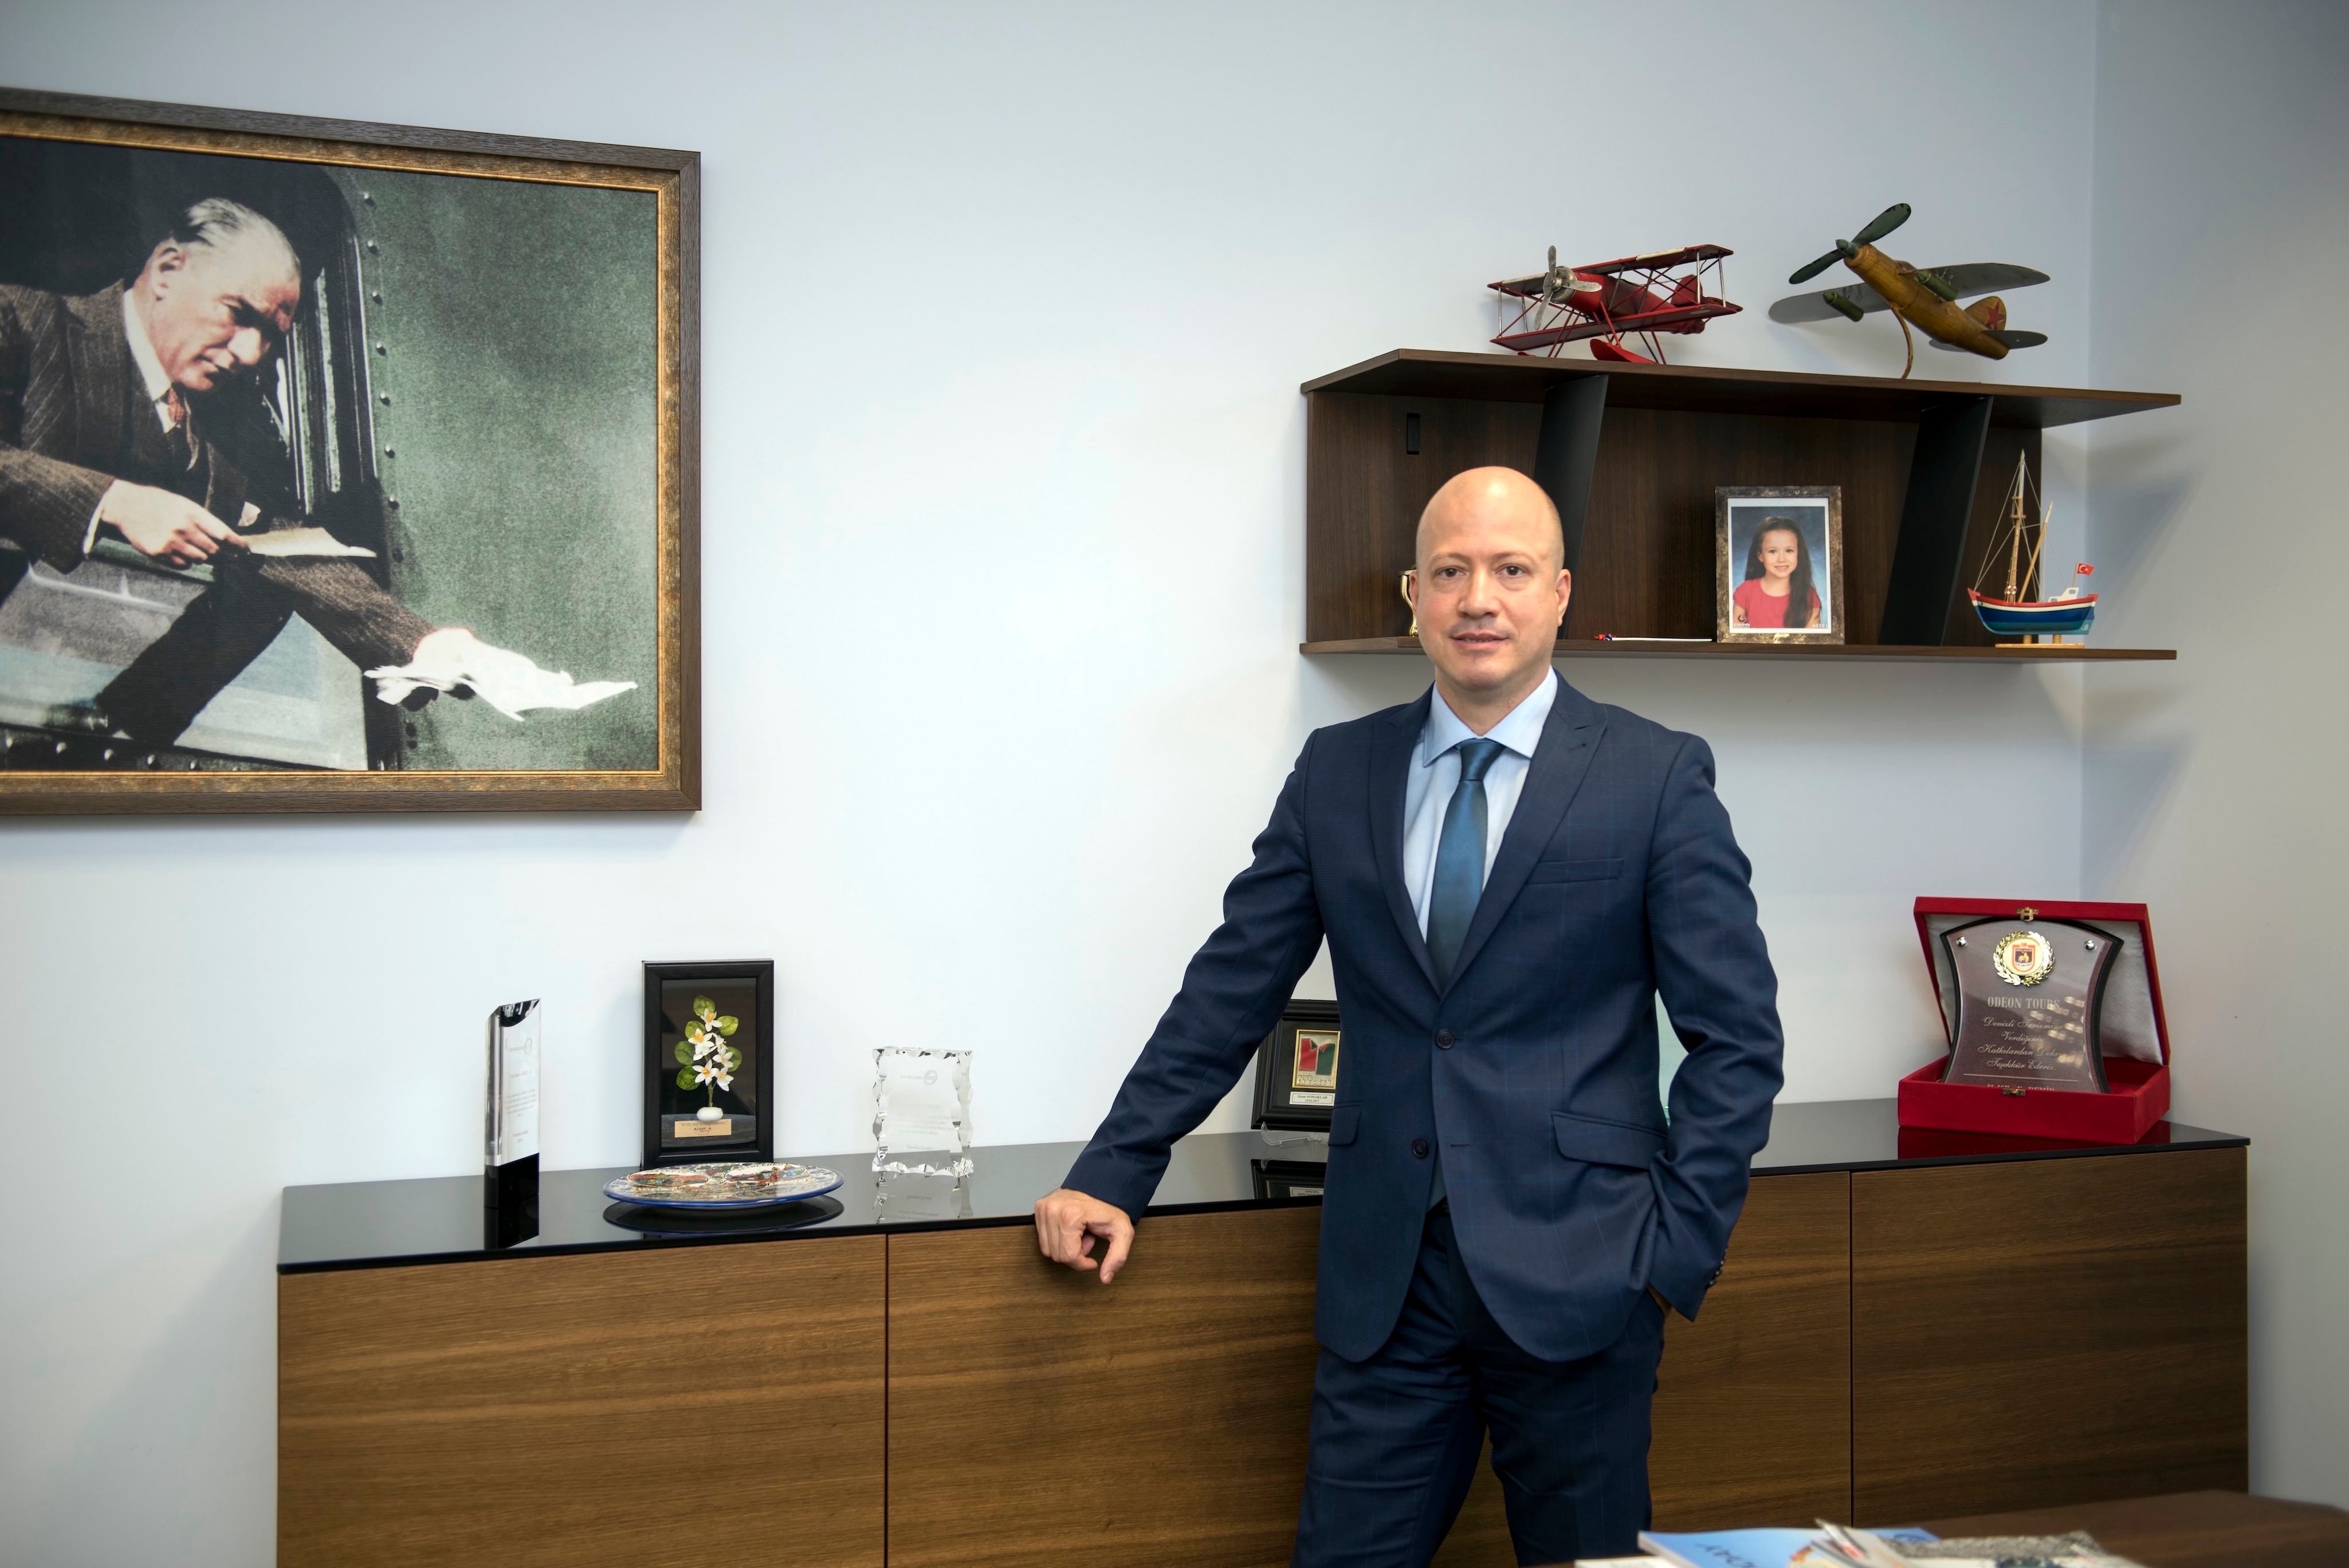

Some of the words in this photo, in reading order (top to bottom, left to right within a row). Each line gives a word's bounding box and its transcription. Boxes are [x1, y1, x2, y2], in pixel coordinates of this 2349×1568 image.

[1987, 996, 2022, 1008] ODEON
[2025, 997, 2060, 1010] TOURS
[1983, 1017, 2016, 1028] Denizli
[1977, 1044, 2033, 1056] Katkılardan
[1986, 1058, 2025, 1070] Teşekkür
